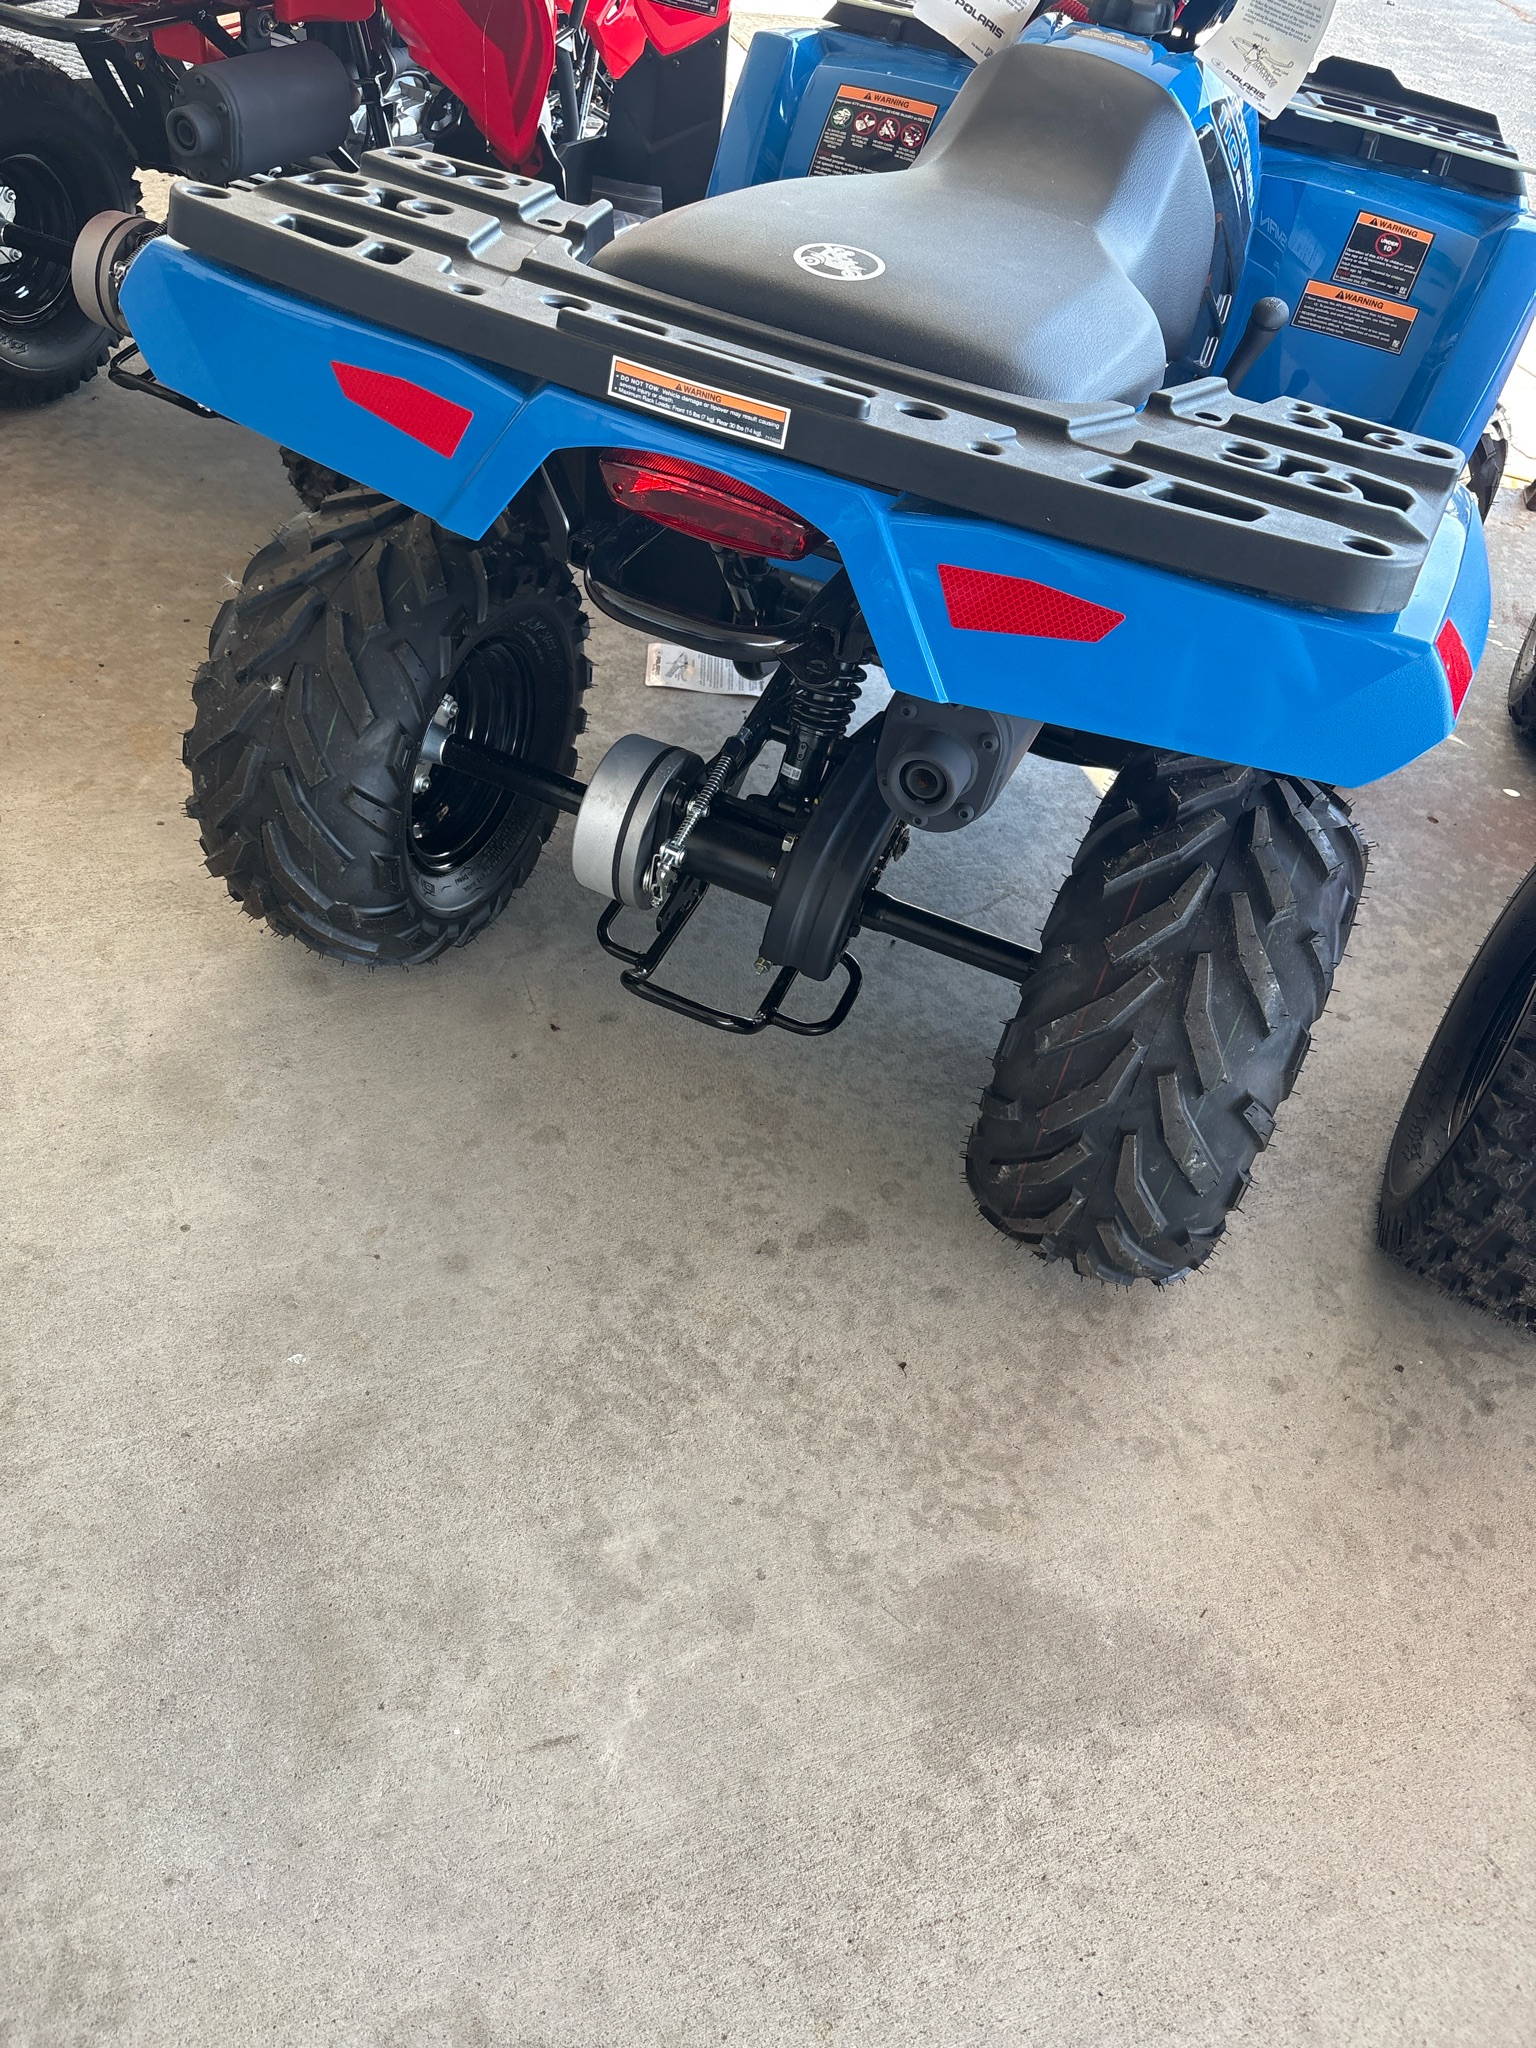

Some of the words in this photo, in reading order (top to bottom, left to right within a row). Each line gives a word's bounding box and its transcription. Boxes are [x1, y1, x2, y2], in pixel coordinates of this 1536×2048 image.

[955, 0, 1005, 38] POLARIS
[1225, 70, 1267, 99] POLARIS
[874, 95, 910, 108] WARNING
[1218, 103, 1240, 172] 110
[1379, 222, 1418, 237] WARNING
[1381, 238, 1399, 247] UNDER
[1345, 294, 1384, 309] WARNING
[620, 383, 636, 391] severe
[638, 388, 651, 396] injury
[620, 388, 641, 398] Maximum
[684, 386, 721, 403] WARNING
[631, 379, 643, 387] NOT
[646, 384, 660, 392] TOW.
[663, 390, 680, 398] Vehicle
[682, 396, 702, 407] damage
[711, 405, 728, 415] tipover
[743, 414, 757, 422] result
[759, 418, 779, 429] causing
